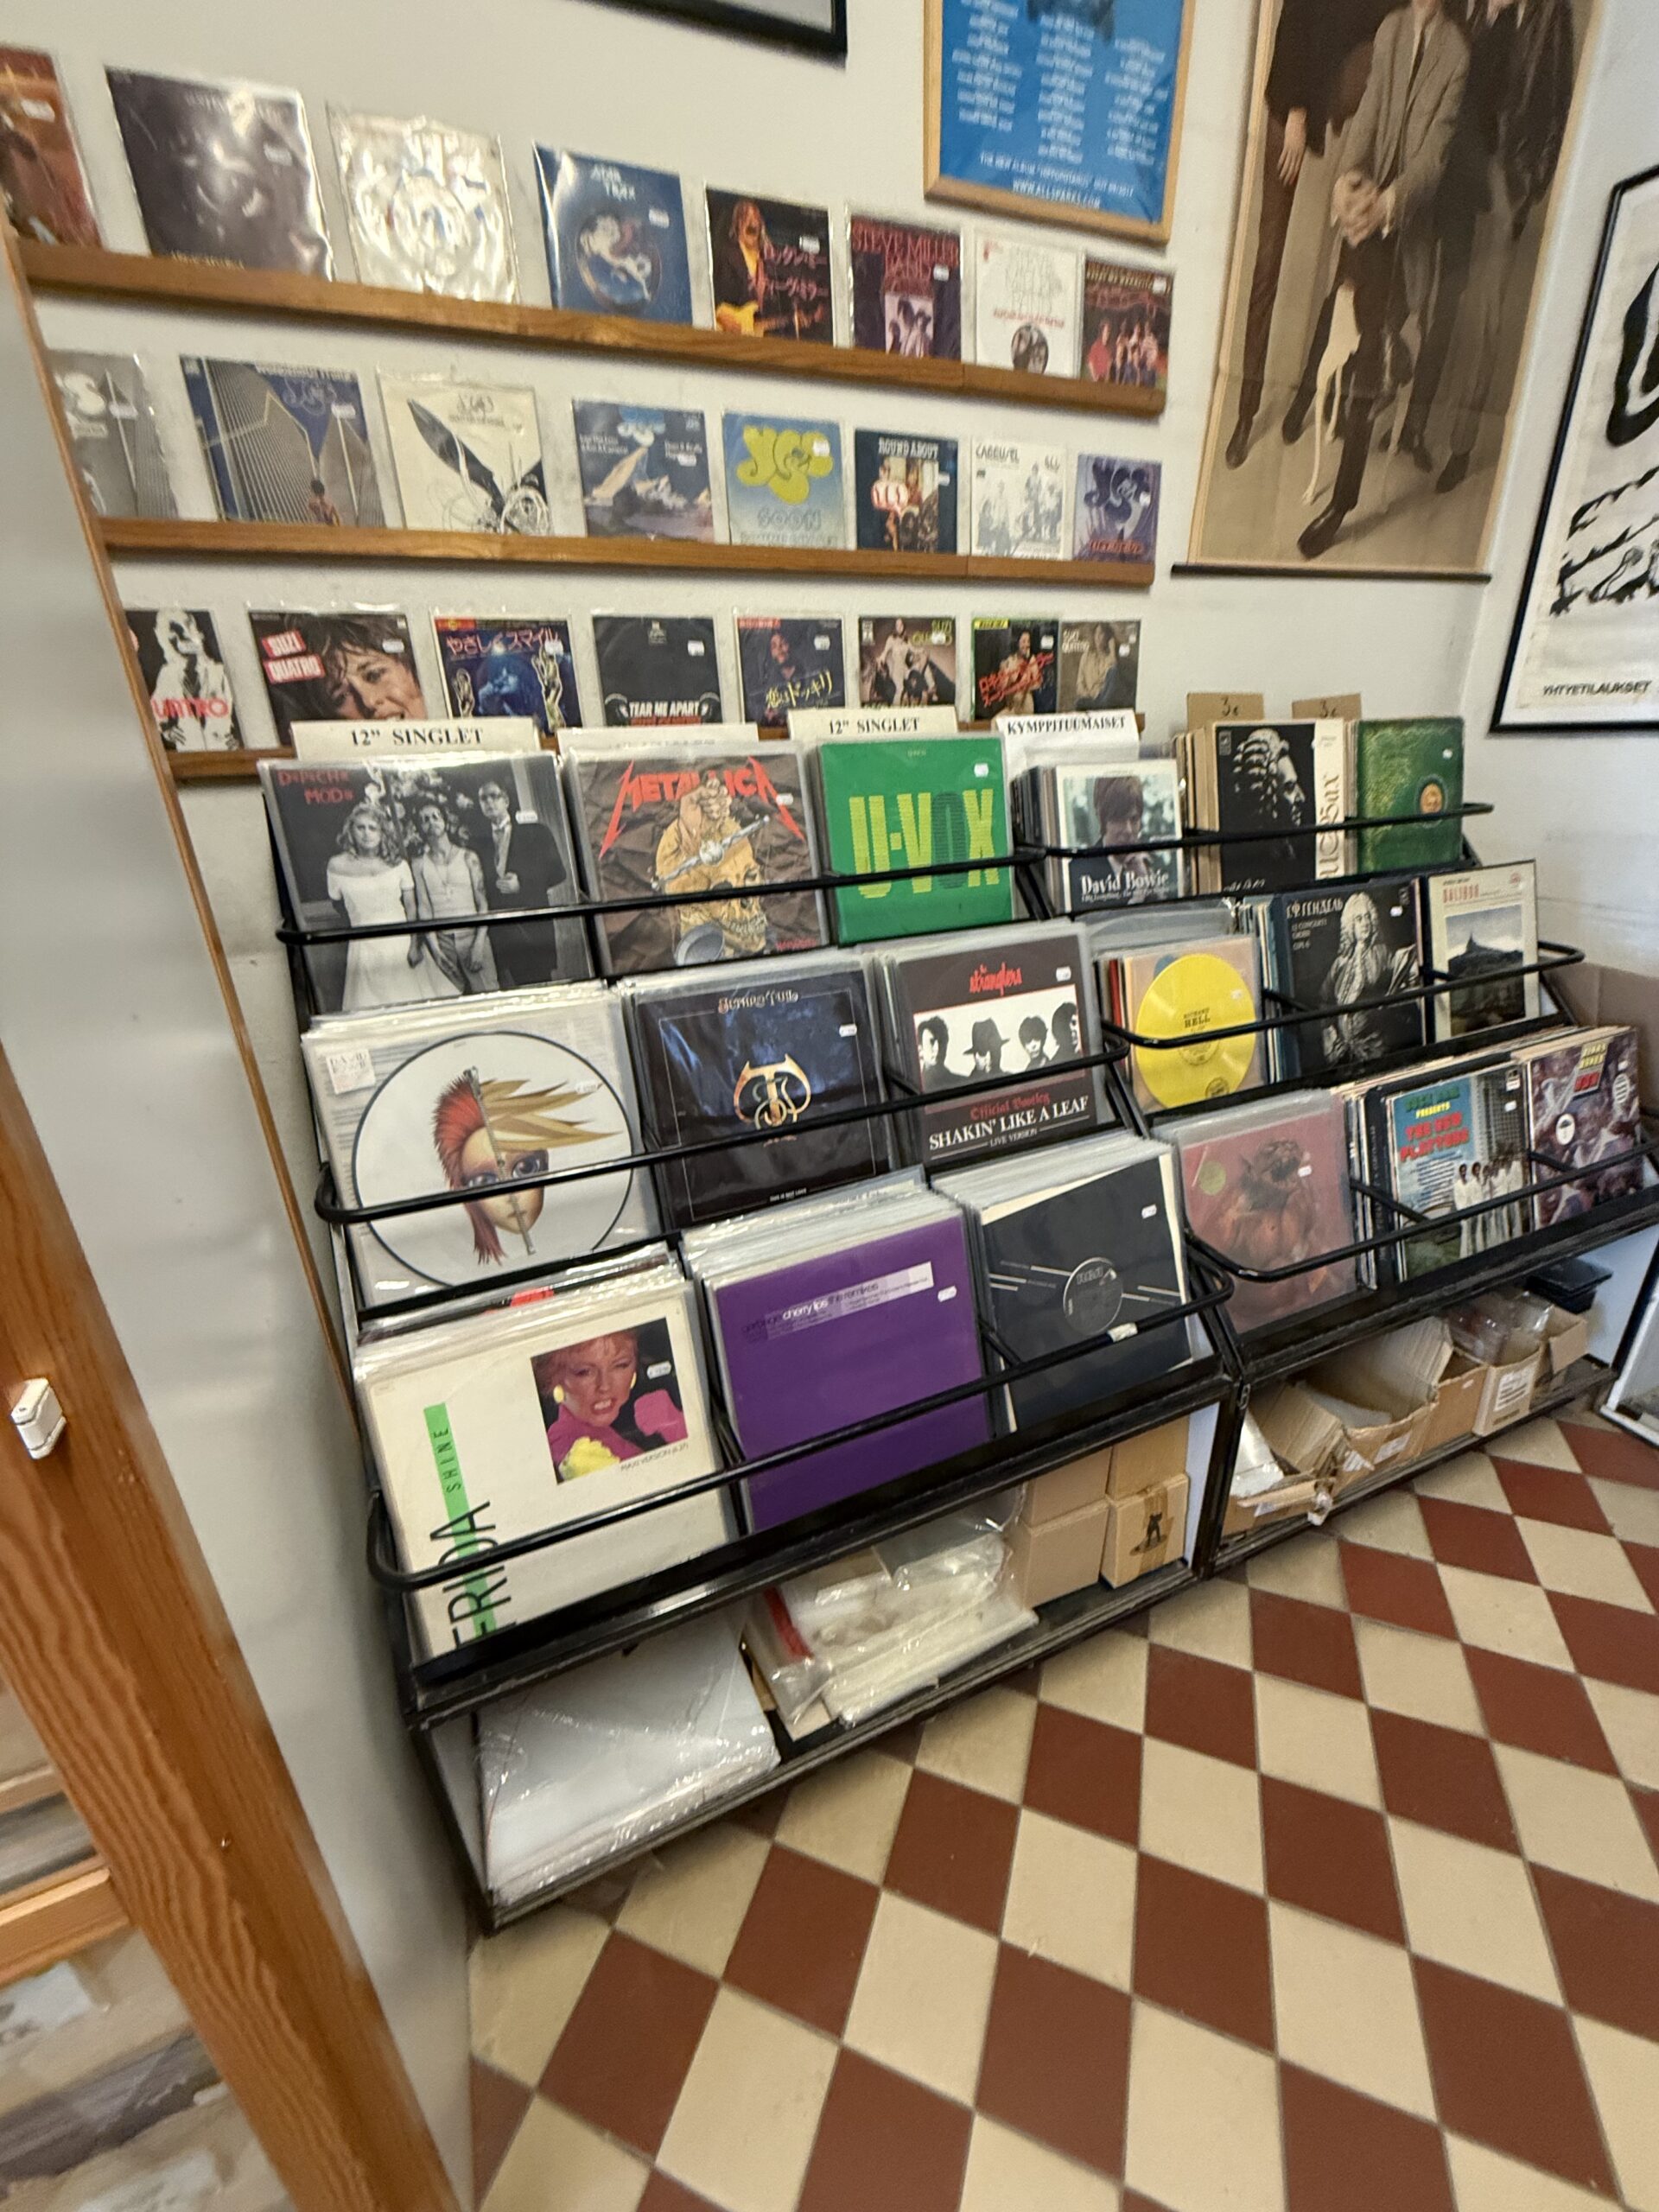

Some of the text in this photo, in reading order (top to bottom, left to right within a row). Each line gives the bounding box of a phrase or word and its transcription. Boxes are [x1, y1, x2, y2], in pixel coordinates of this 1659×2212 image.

[629, 701, 652, 718] TEAR
[670, 699, 701, 718] APART
[829, 717, 920, 734] 12" SINGLET
[1007, 716, 1127, 735] KYMPPITUUMAISET
[351, 728, 486, 747] 12" SINGLET
[598, 754, 805, 861] METAICA
[849, 788, 1000, 899] U-VOX
[1080, 874, 1122, 896] David
[1126, 868, 1169, 891] Bowie
[1184, 1014, 1211, 1029] HELL
[969, 1098, 1011, 1121] Official
[929, 1095, 1089, 1151] SHAKIN' LIKE A LEAF
[989, 1128, 1039, 1147] LIVE VERSION
[781, 1301, 812, 1322] cherry
[812, 1297, 830, 1313] lips
[432, 1426, 461, 1494] SHINE
[642, 1449, 671, 1467] VERSION
